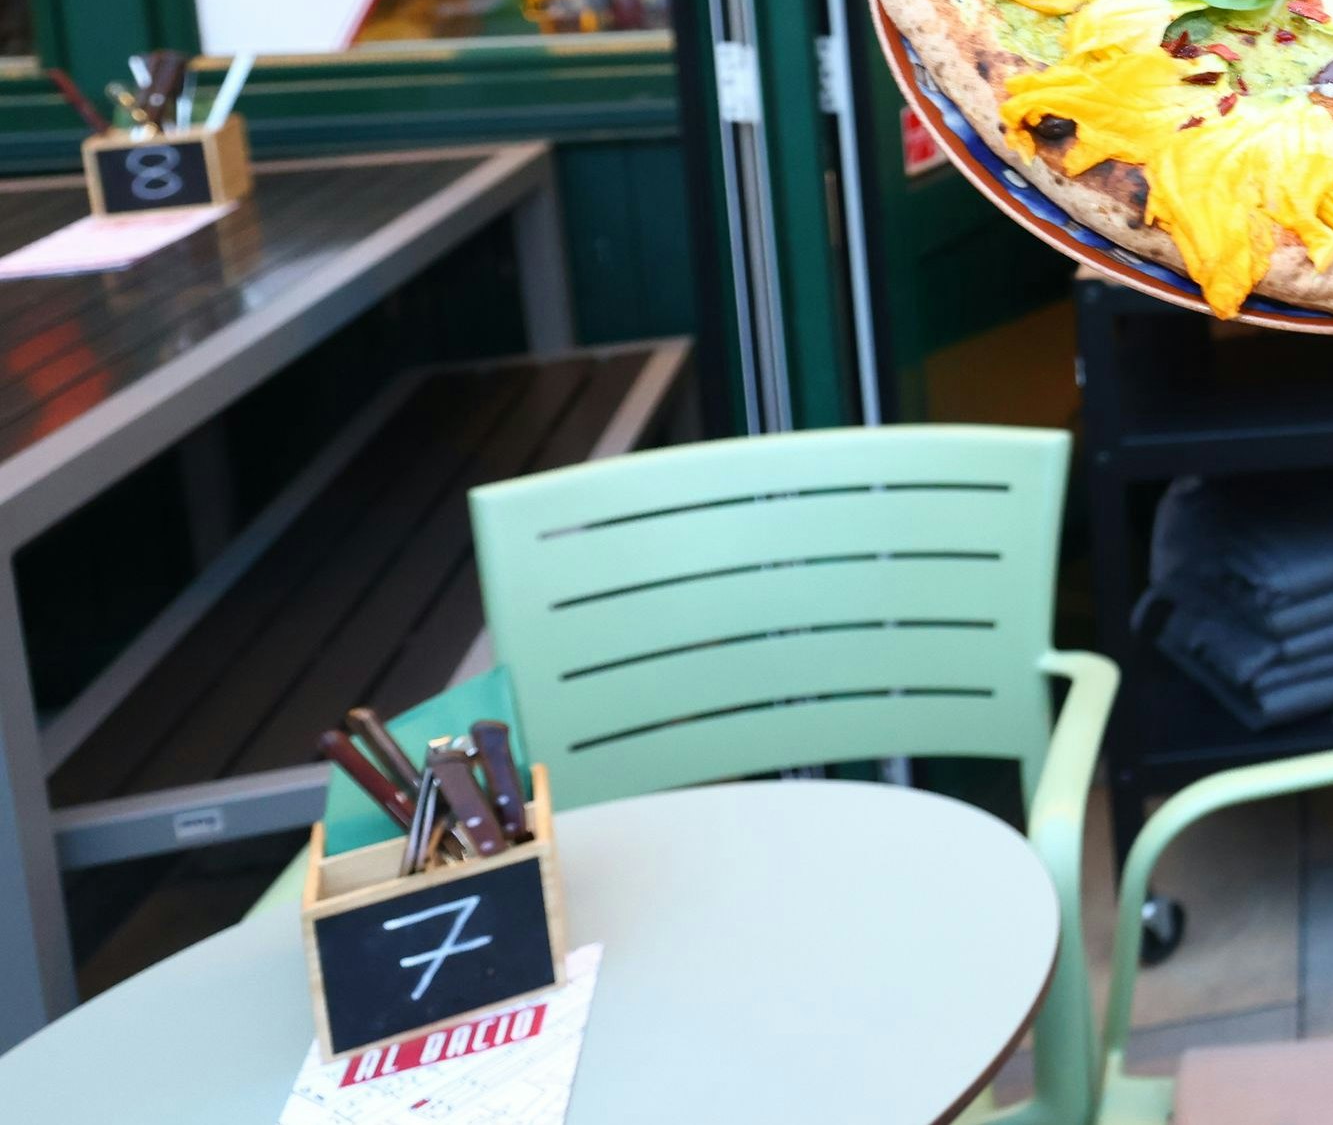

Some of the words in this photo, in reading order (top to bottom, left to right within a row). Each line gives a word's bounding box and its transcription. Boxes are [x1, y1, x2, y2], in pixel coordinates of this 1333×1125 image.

[125, 143, 183, 200] 8
[383, 895, 493, 1001] 7
[353, 1043, 401, 1083] AL
[419, 1007, 536, 1065] BACIO
